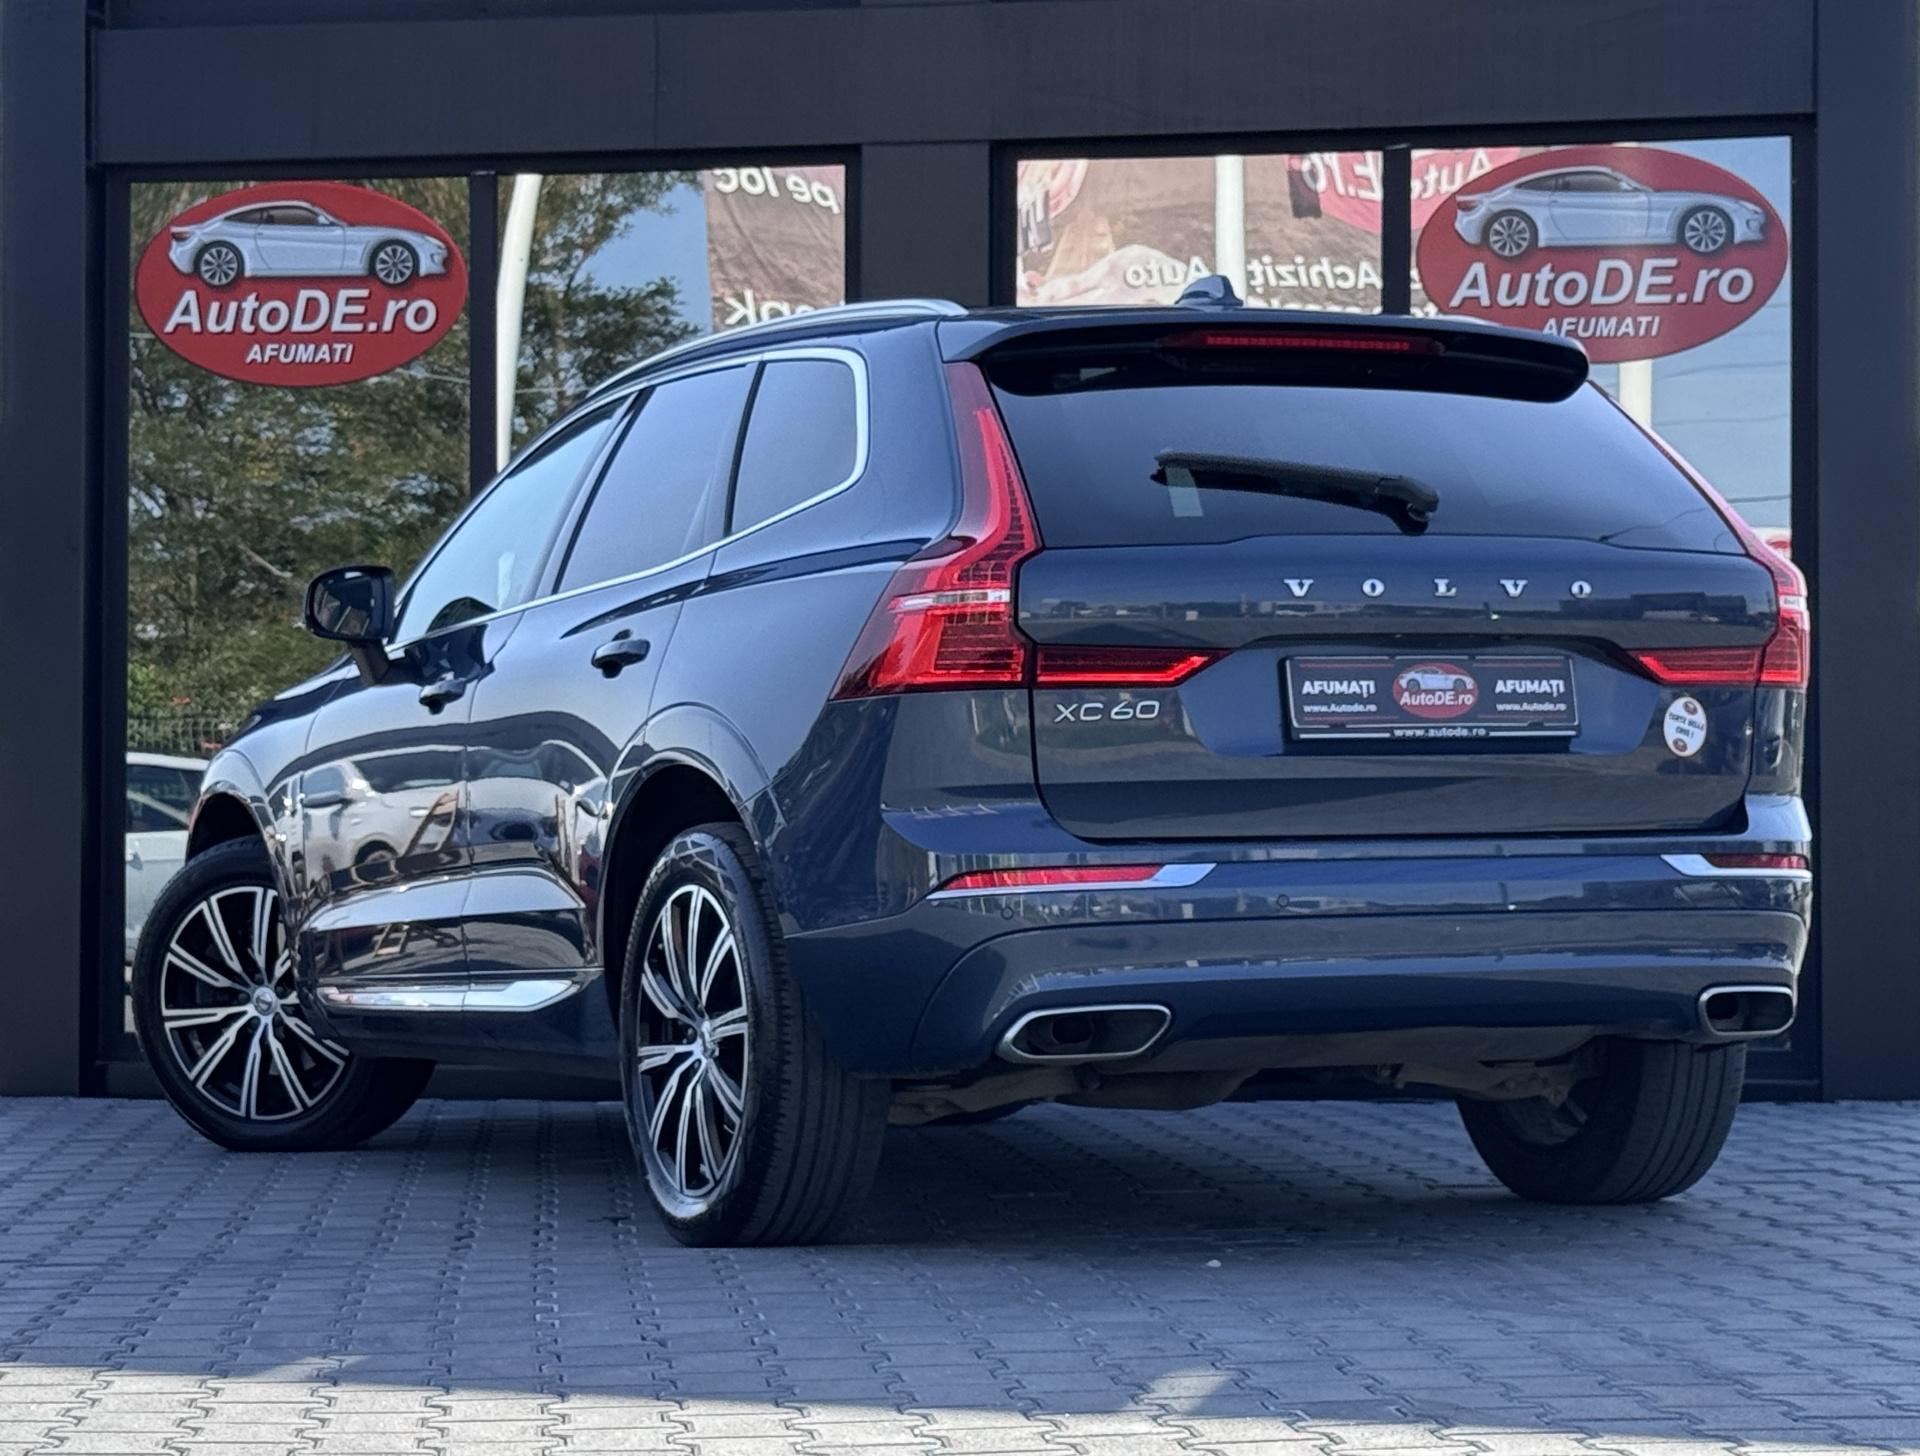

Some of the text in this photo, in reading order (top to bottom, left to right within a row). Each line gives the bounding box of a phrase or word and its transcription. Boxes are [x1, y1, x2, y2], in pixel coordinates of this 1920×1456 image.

[1449, 257, 1755, 308] AutoDE.ro
[164, 288, 438, 333] AutoDE.ro
[1542, 316, 1660, 338] AFUMATI
[245, 343, 354, 364] AFUMATI
[1284, 578, 1592, 598] VOLVO
[1400, 690, 1474, 706] AutoDE.ro
[1054, 700, 1160, 722] XC60
